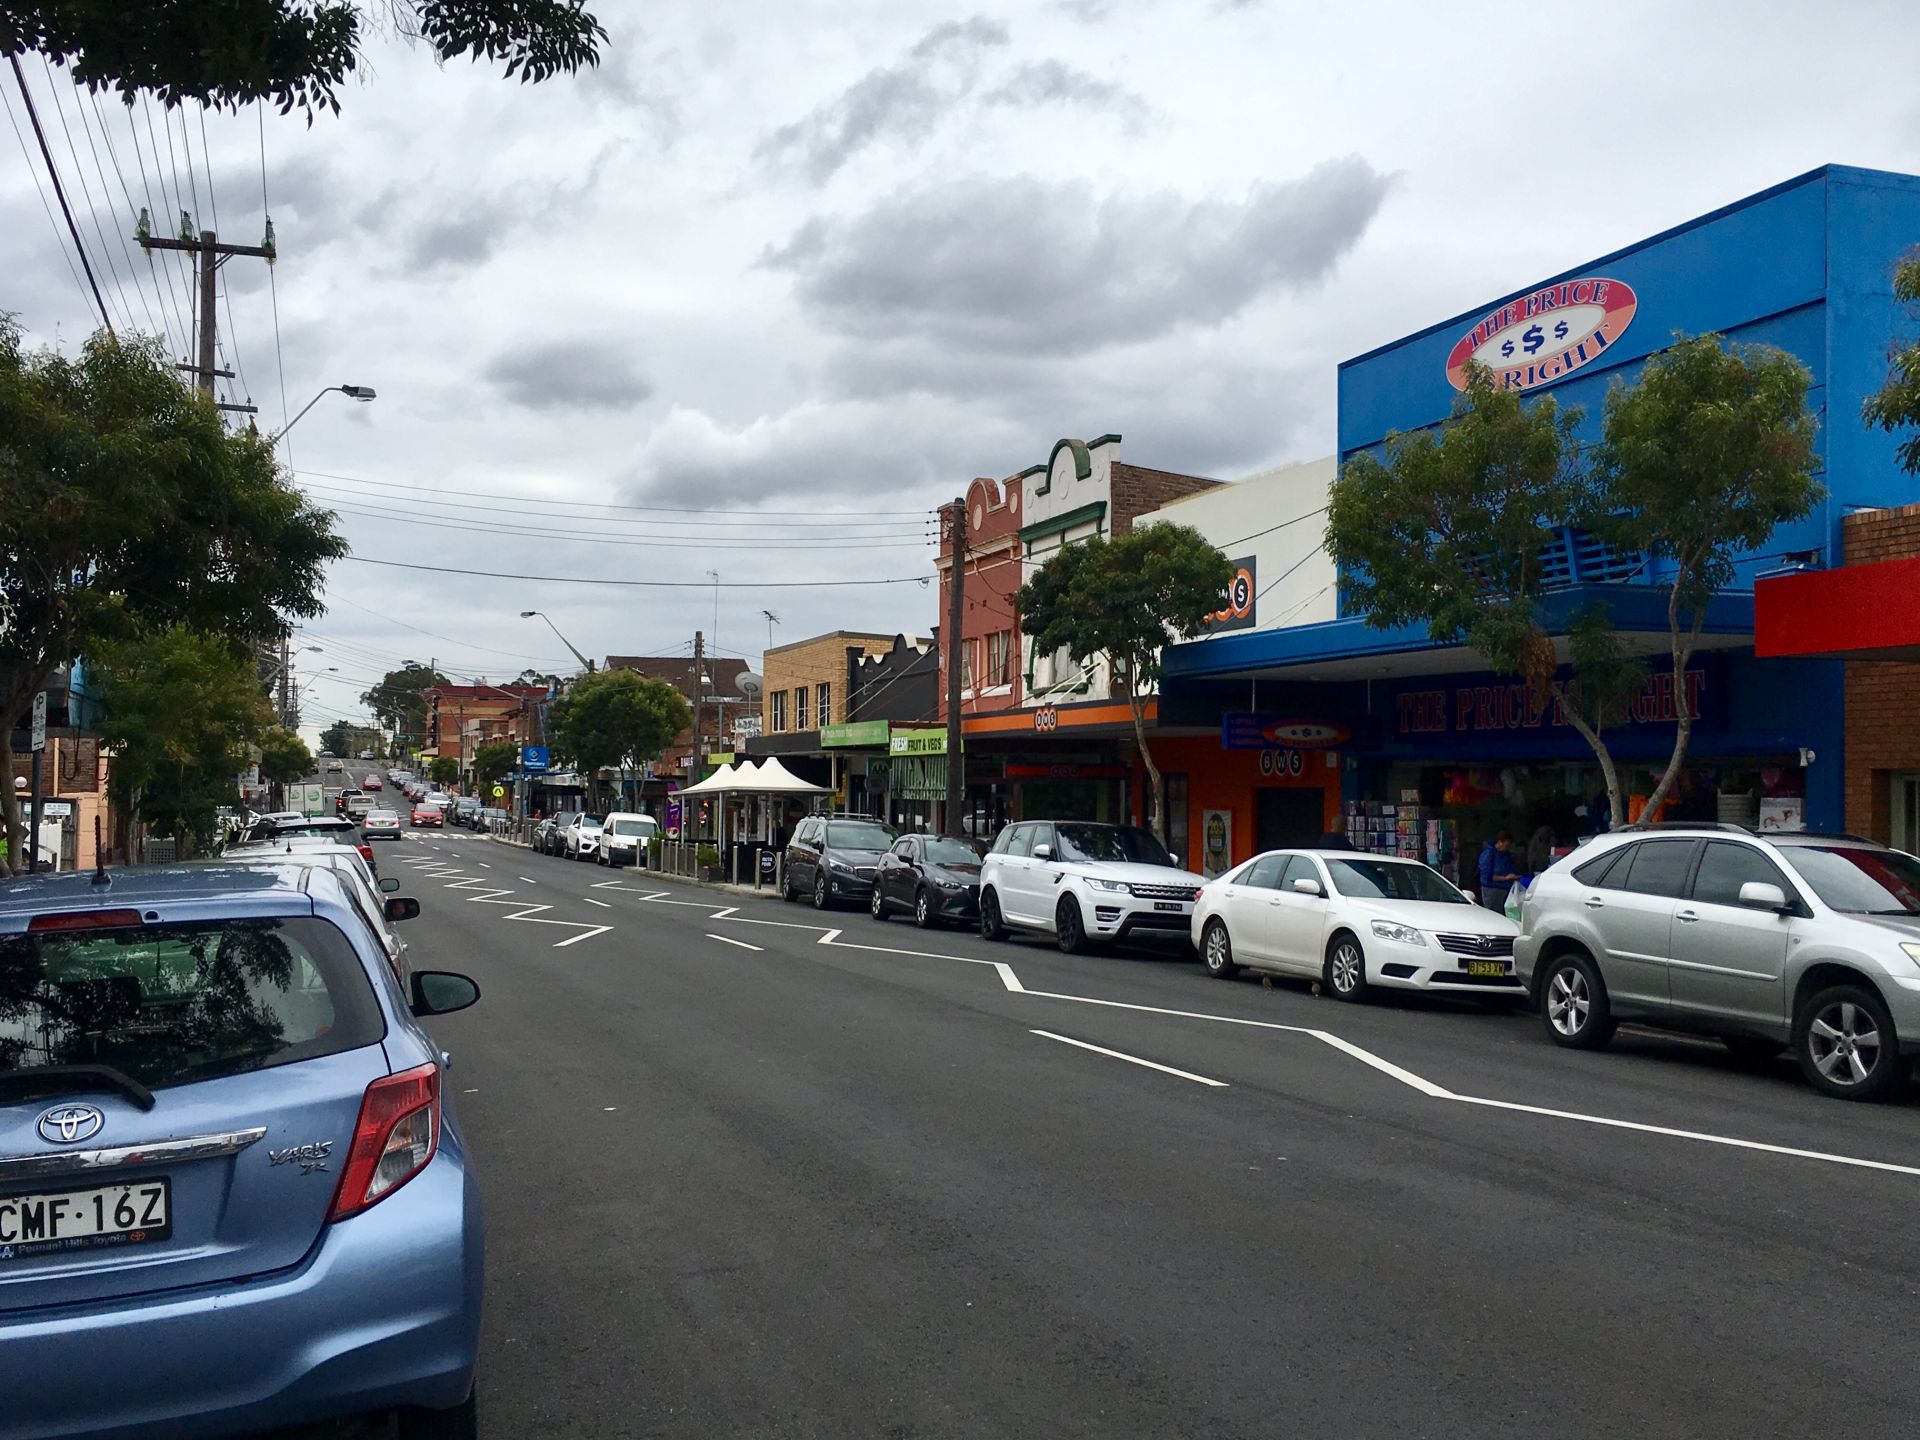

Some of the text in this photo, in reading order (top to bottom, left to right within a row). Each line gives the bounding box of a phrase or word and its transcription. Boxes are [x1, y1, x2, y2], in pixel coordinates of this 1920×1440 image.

[1466, 279, 1611, 351] THE PRICE
[1504, 322, 1612, 390] RIGHT
[1396, 690, 1447, 733] THE
[1455, 678, 1543, 731] PRICE
[907, 739, 922, 752] FRUIT
[269, 1140, 333, 1167] YARIS
[18, 1240, 63, 1255] Pennant
[65, 1238, 90, 1248] Hills
[93, 1232, 127, 1246] Toyota
